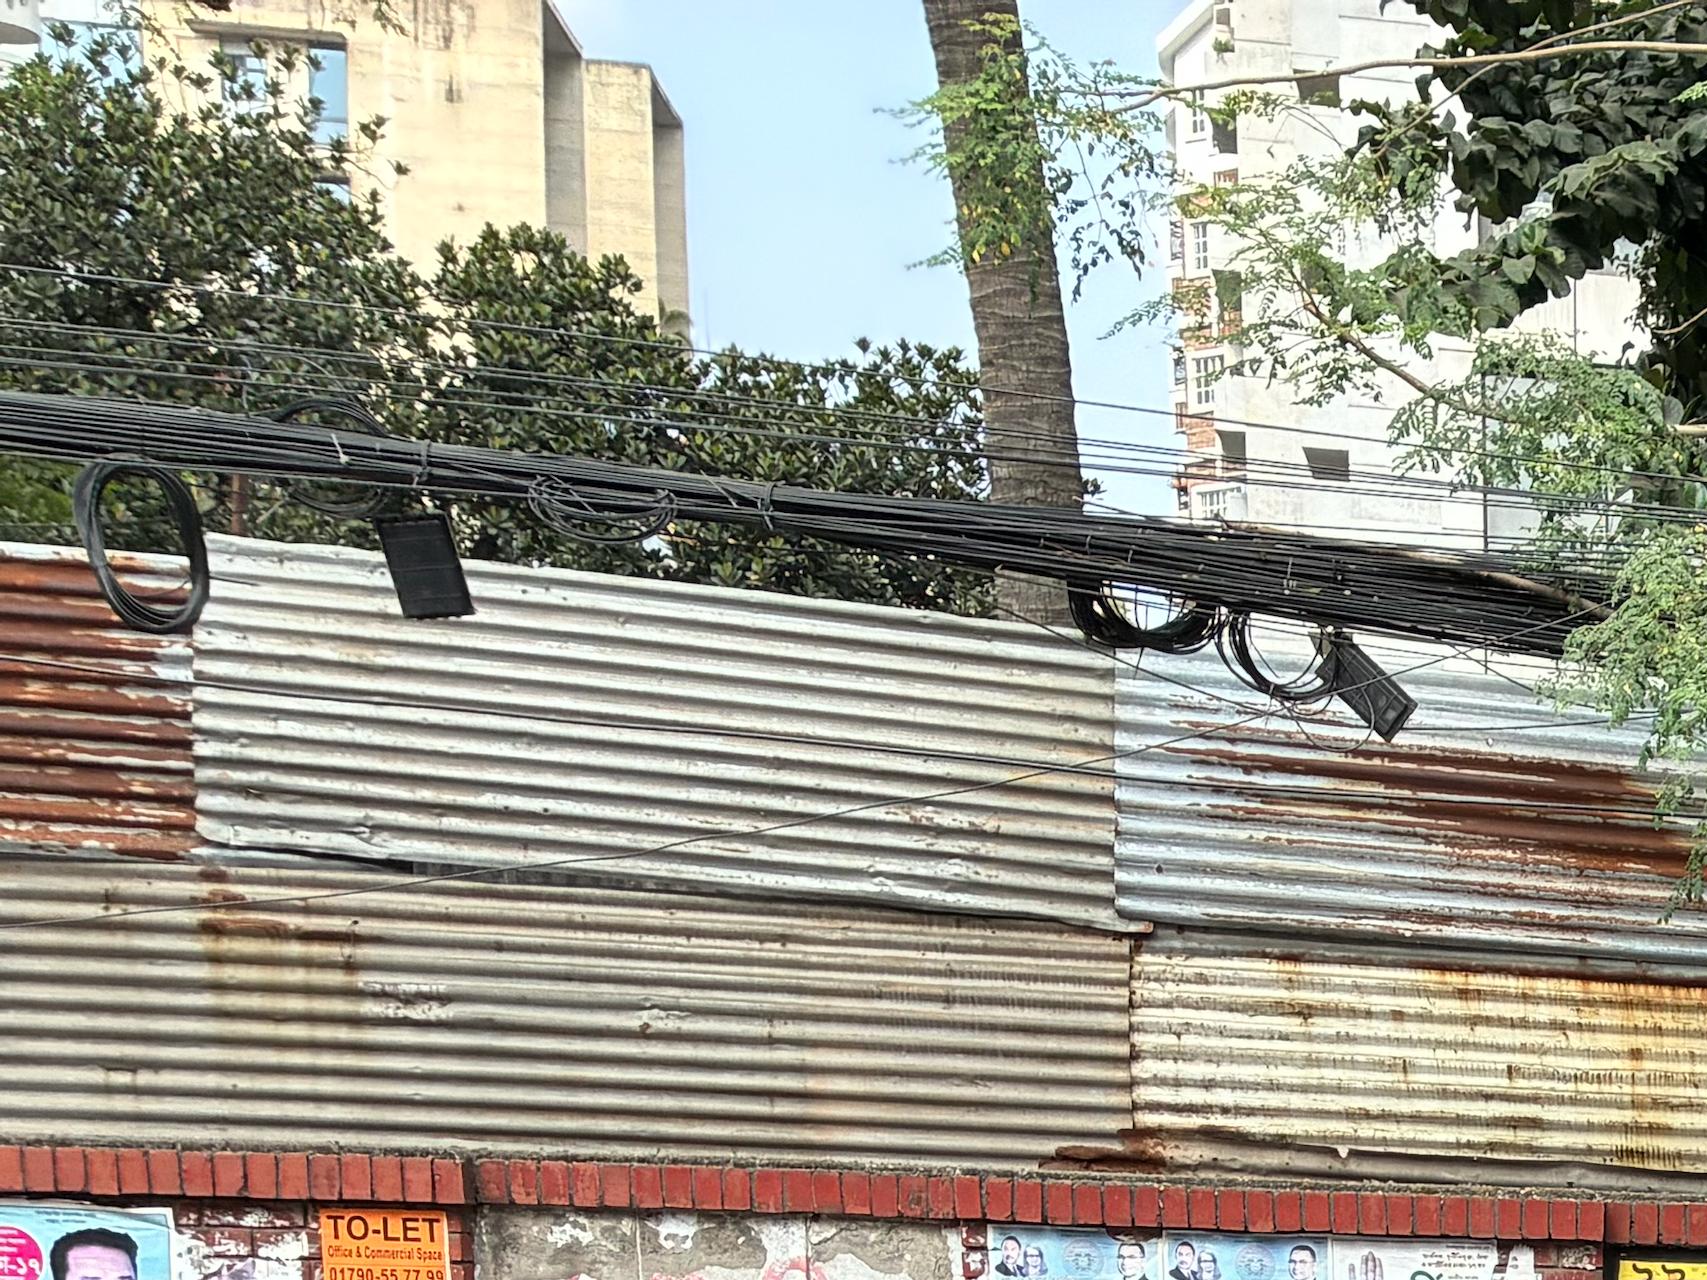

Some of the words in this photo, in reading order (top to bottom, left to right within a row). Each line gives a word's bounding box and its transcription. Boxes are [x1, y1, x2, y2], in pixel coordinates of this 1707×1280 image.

[326, 1215, 441, 1242] TO-LET
[327, 1245, 352, 1258] Office
[355, 1246, 362, 1258] &
[364, 1246, 414, 1260] Commercial
[417, 1247, 442, 1263] Space
